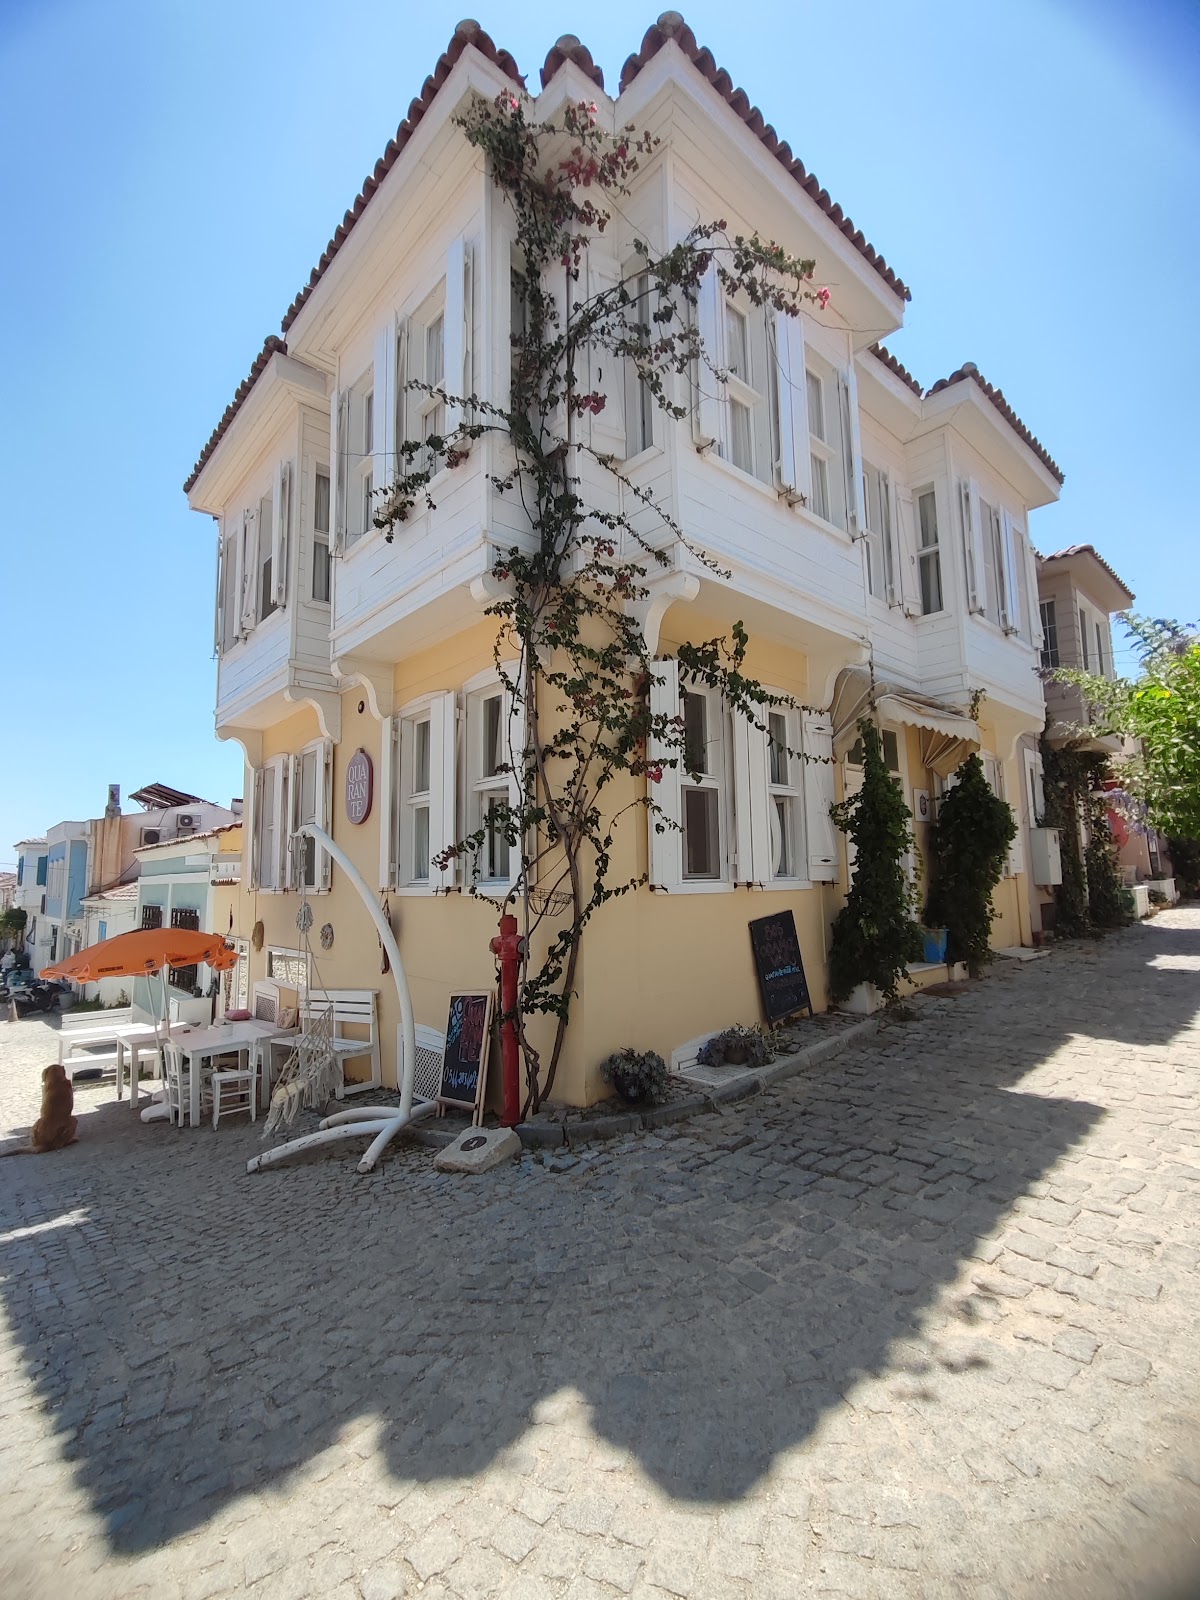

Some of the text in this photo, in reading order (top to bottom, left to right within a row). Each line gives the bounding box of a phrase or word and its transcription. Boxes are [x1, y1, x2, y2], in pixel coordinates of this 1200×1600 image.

[348, 764, 367, 784] QUA
[348, 782, 366, 801] RAN
[351, 801, 363, 817] TE
